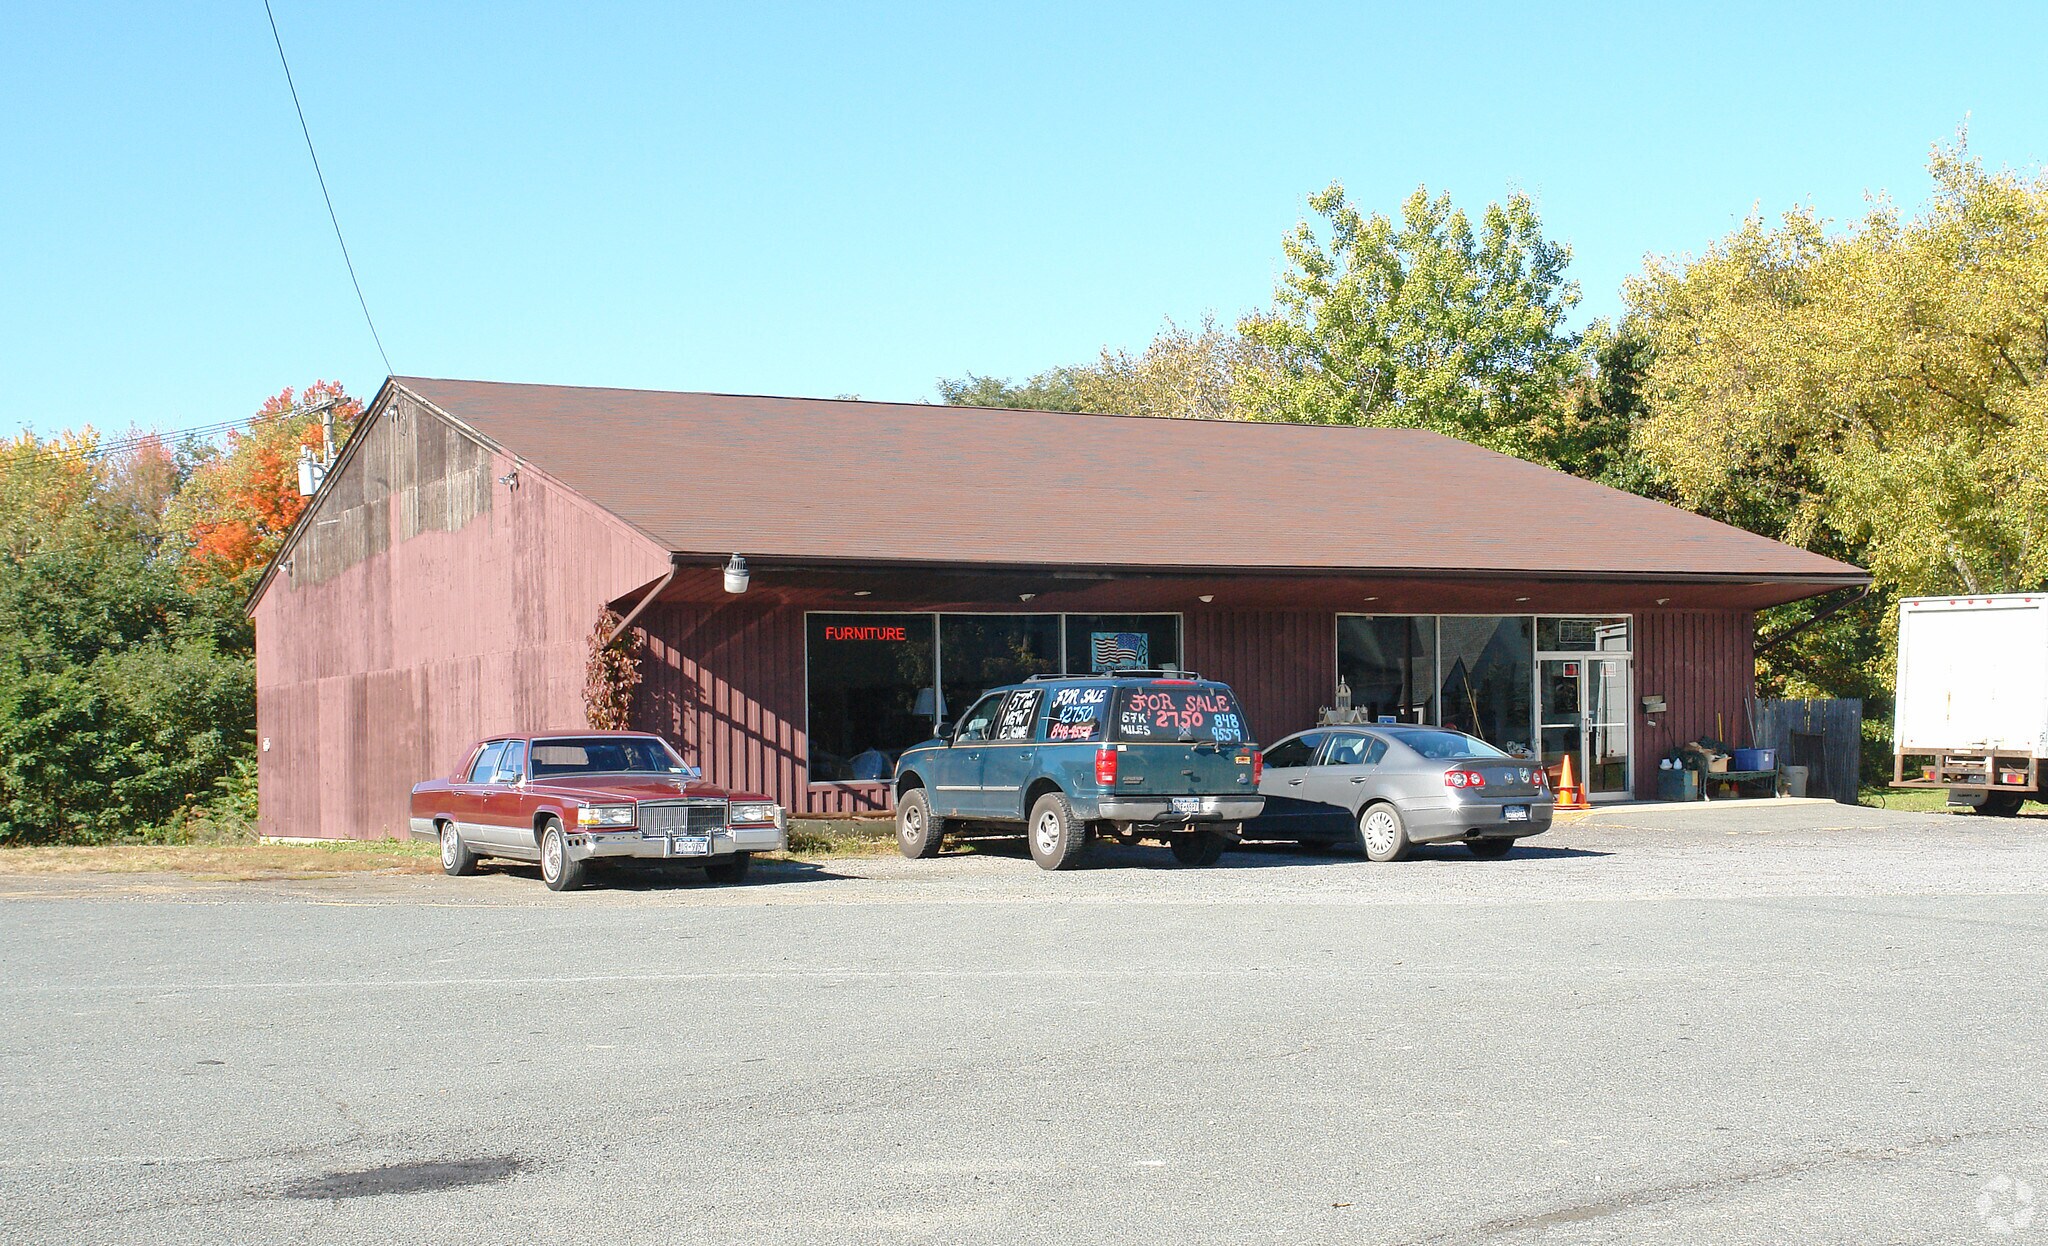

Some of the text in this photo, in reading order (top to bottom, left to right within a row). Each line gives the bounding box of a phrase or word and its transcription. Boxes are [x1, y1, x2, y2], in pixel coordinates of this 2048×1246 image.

[825, 626, 906, 640] FURNITURE
[1053, 688, 1106, 708] FOR SALE
[1129, 694, 1230, 712] FOR SALE
[1002, 709, 1031, 726] NEW
[1059, 705, 1094, 723] $2750
[1213, 714, 1239, 728] 848
[1120, 724, 1151, 736] MILES
[1211, 727, 1241, 742] 9559
